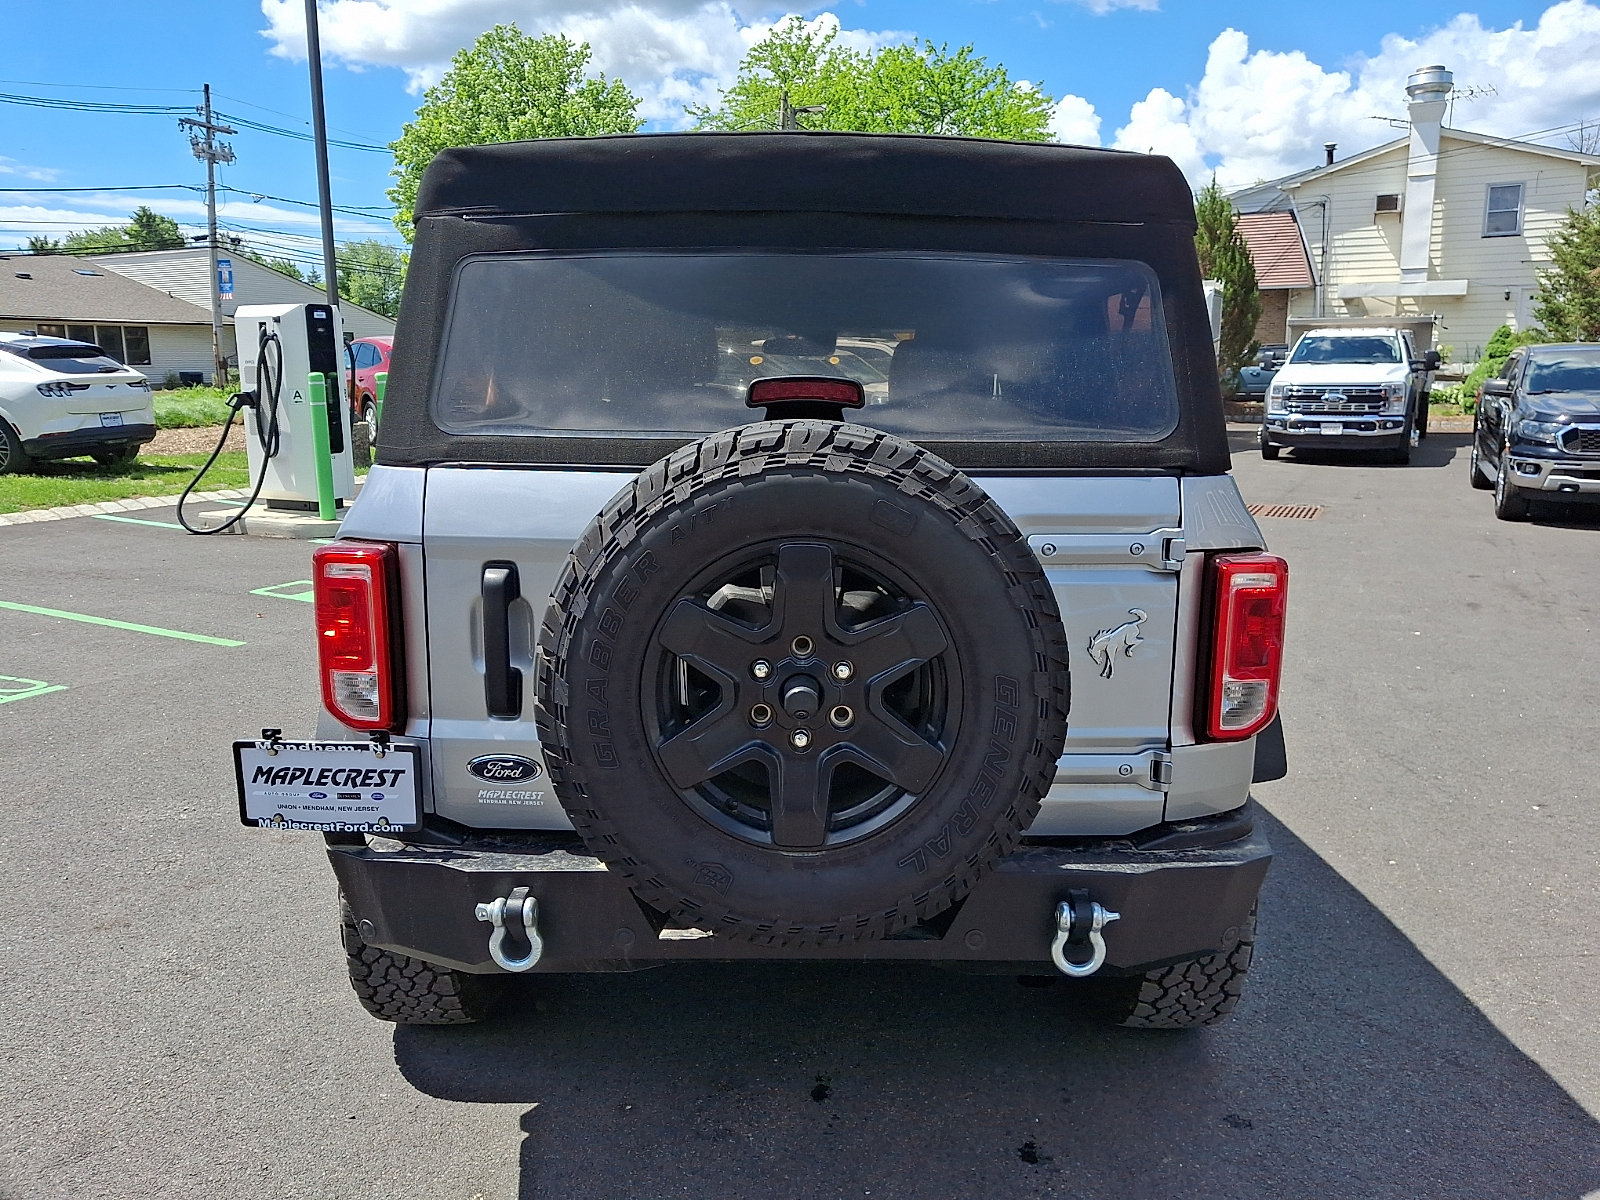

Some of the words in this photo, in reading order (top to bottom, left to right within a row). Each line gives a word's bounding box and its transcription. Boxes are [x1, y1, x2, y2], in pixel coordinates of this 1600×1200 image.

[293, 390, 303, 400] A
[585, 549, 662, 770] GRABBER
[252, 765, 406, 789] MAPLECREST
[483, 761, 523, 778] Ford
[898, 674, 1019, 875] GENERAL
[478, 789, 545, 800] MAPLECREST
[258, 819, 404, 832] MaplecrestFord.com
